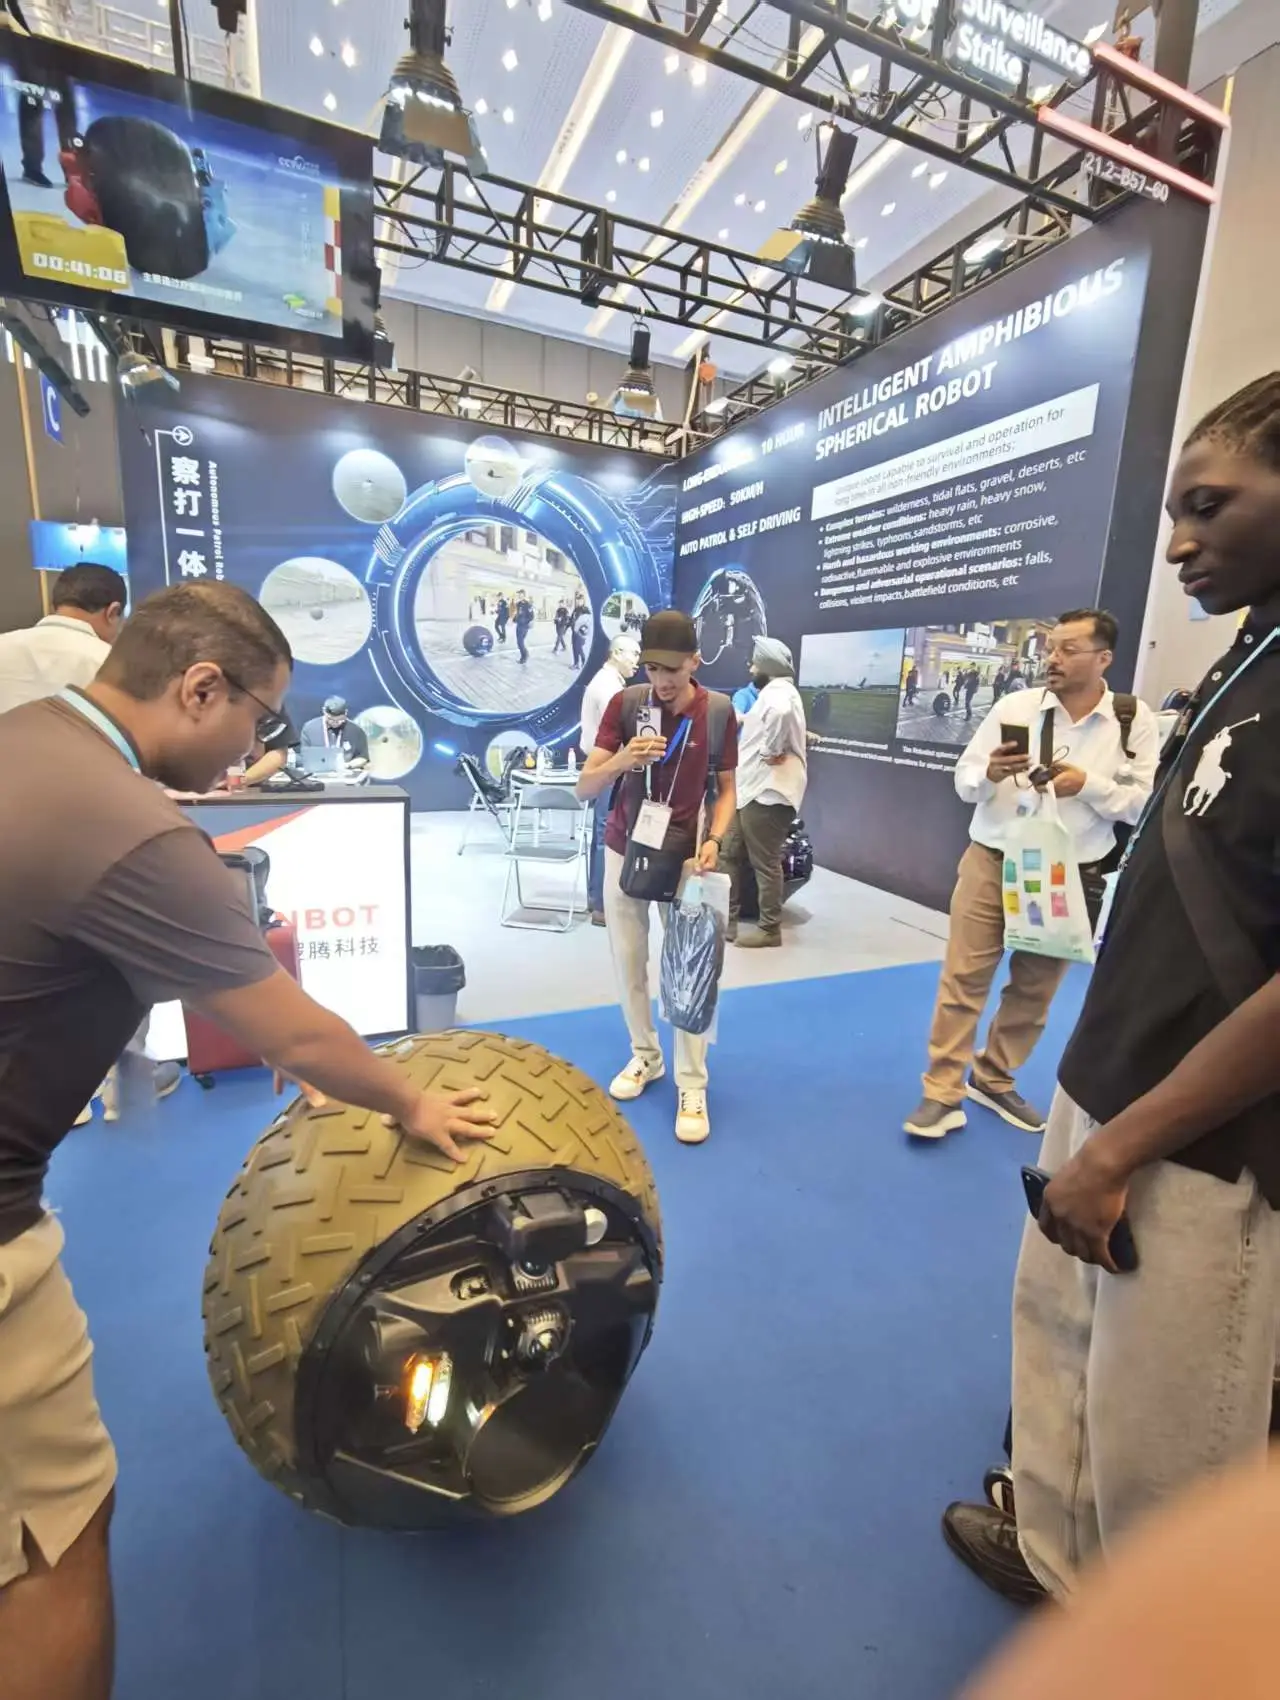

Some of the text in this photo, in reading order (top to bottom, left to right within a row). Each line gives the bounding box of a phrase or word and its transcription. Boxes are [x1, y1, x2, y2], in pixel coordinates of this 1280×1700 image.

[957, 23, 1023, 85] Strike
[817, 257, 1125, 432] INTELLIGENT AMPHIBIOUS
[815, 361, 997, 461] SPHERICAL ROBOT
[916, 458, 926, 469] to
[927, 443, 963, 465] survival
[965, 433, 986, 451] and
[988, 416, 1044, 444] operation
[1046, 407, 1065, 423] for
[207, 459, 221, 528] Autonomous
[882, 512, 927, 531] conditions:
[929, 504, 955, 520] heavy
[956, 498, 978, 513] rain,
[980, 489, 1011, 506] heavy
[1013, 480, 1047, 498] snow,
[886, 497, 931, 515] wilderness,
[932, 485, 953, 503] tidal
[955, 481, 978, 497] flats,
[980, 469, 1016, 491] gravel,
[1018, 457, 1063, 479] deserts,
[1066, 448, 1087, 465] etc
[170, 455, 208, 578] 察打一体
[679, 539, 699, 557] AUTO
[699, 530, 728, 551] PATROL
[737, 520, 758, 540] SELF
[759, 506, 801, 533] DRIVING
[895, 542, 930, 557] working
[931, 527, 1002, 550] environments:
[1004, 514, 1059, 535] corrosive,
[968, 513, 983, 526] etc
[212, 528, 224, 559] Patrol
[895, 558, 912, 572] and
[912, 551, 952, 569] explosive
[953, 539, 1022, 561] environments
[855, 580, 870, 591] and
[914, 564, 967, 583] operational
[967, 557, 1023, 575] scenarios:
[1024, 550, 1053, 566] falls,
[947, 577, 1000, 594] conditions,
[1002, 574, 1020, 587] etc
